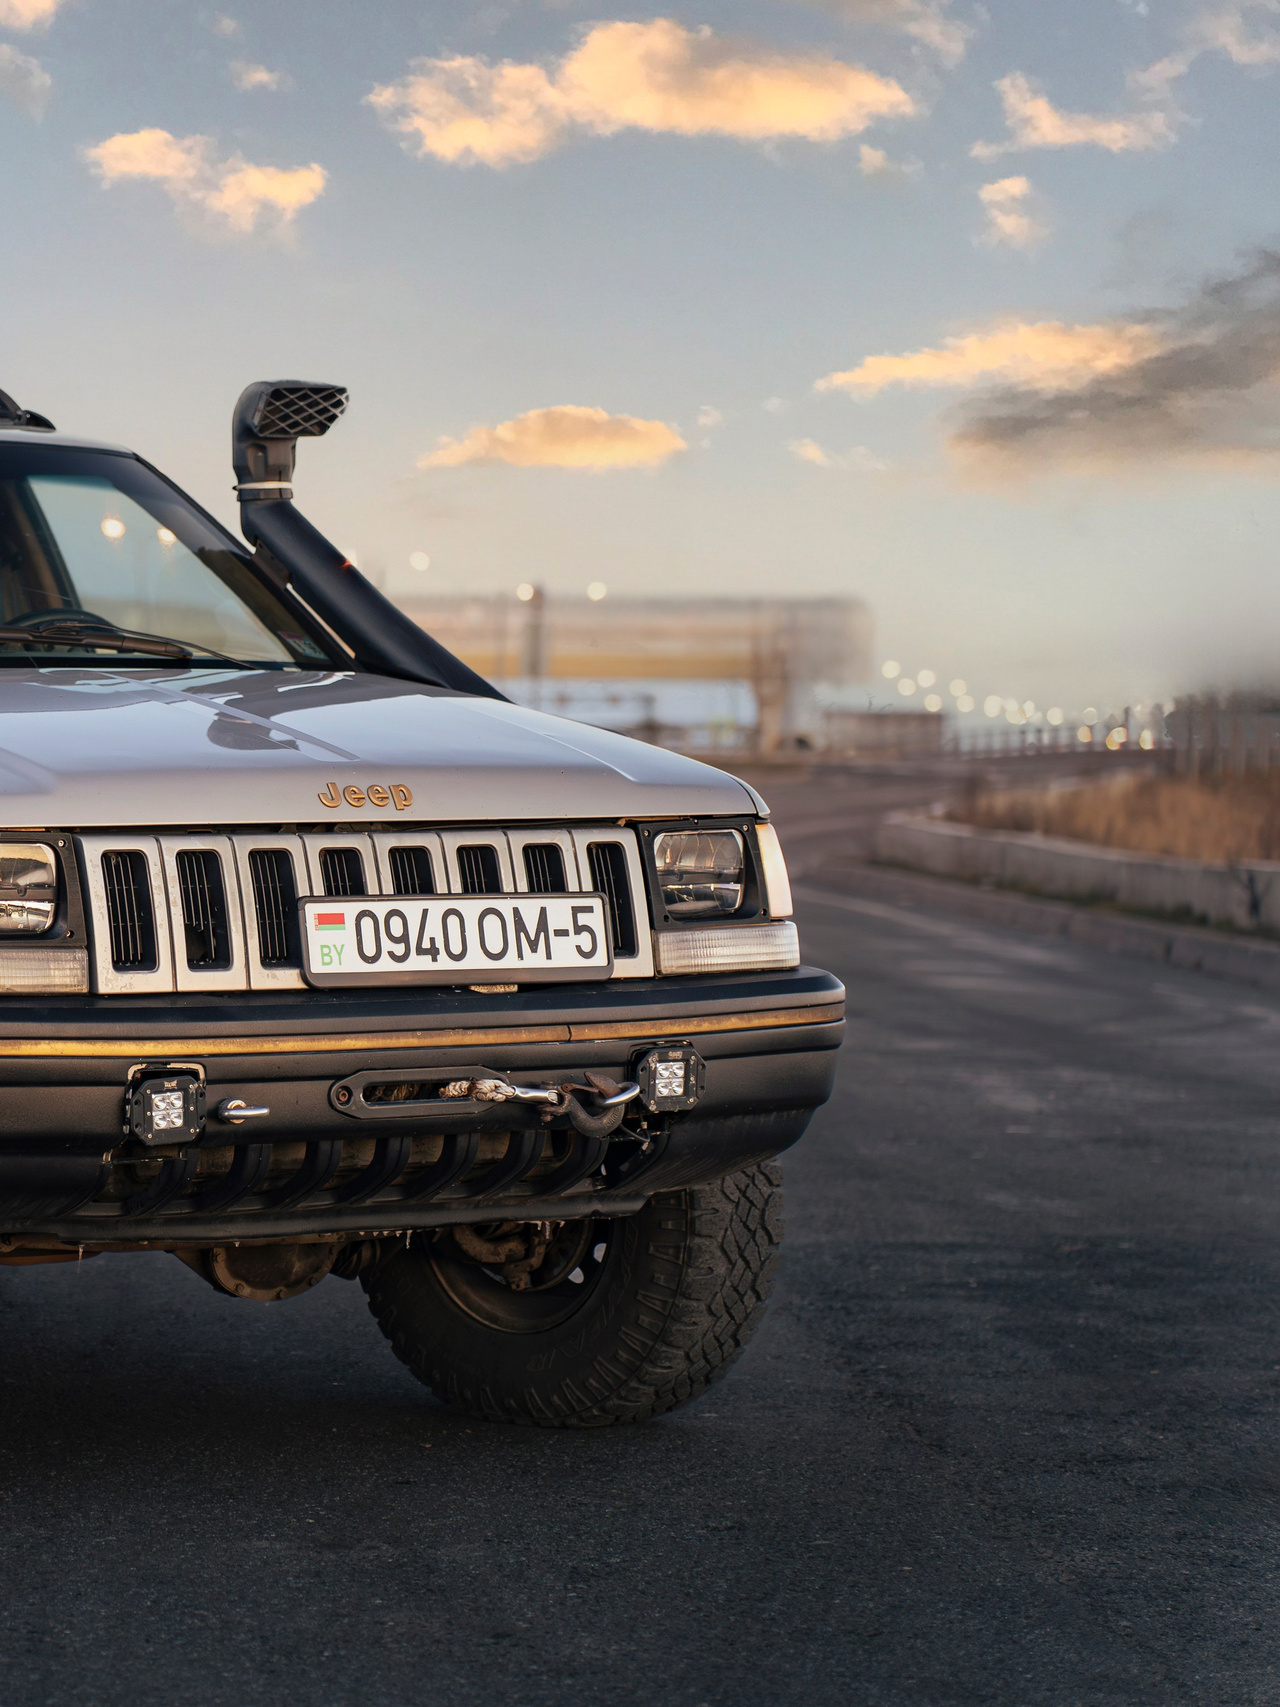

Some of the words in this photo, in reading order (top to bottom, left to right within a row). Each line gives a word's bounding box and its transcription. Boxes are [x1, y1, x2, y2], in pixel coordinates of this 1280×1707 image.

[317, 781, 414, 811] Jeep
[354, 907, 469, 965] 0940
[477, 905, 598, 961] OM-5
[320, 943, 345, 967] BY
